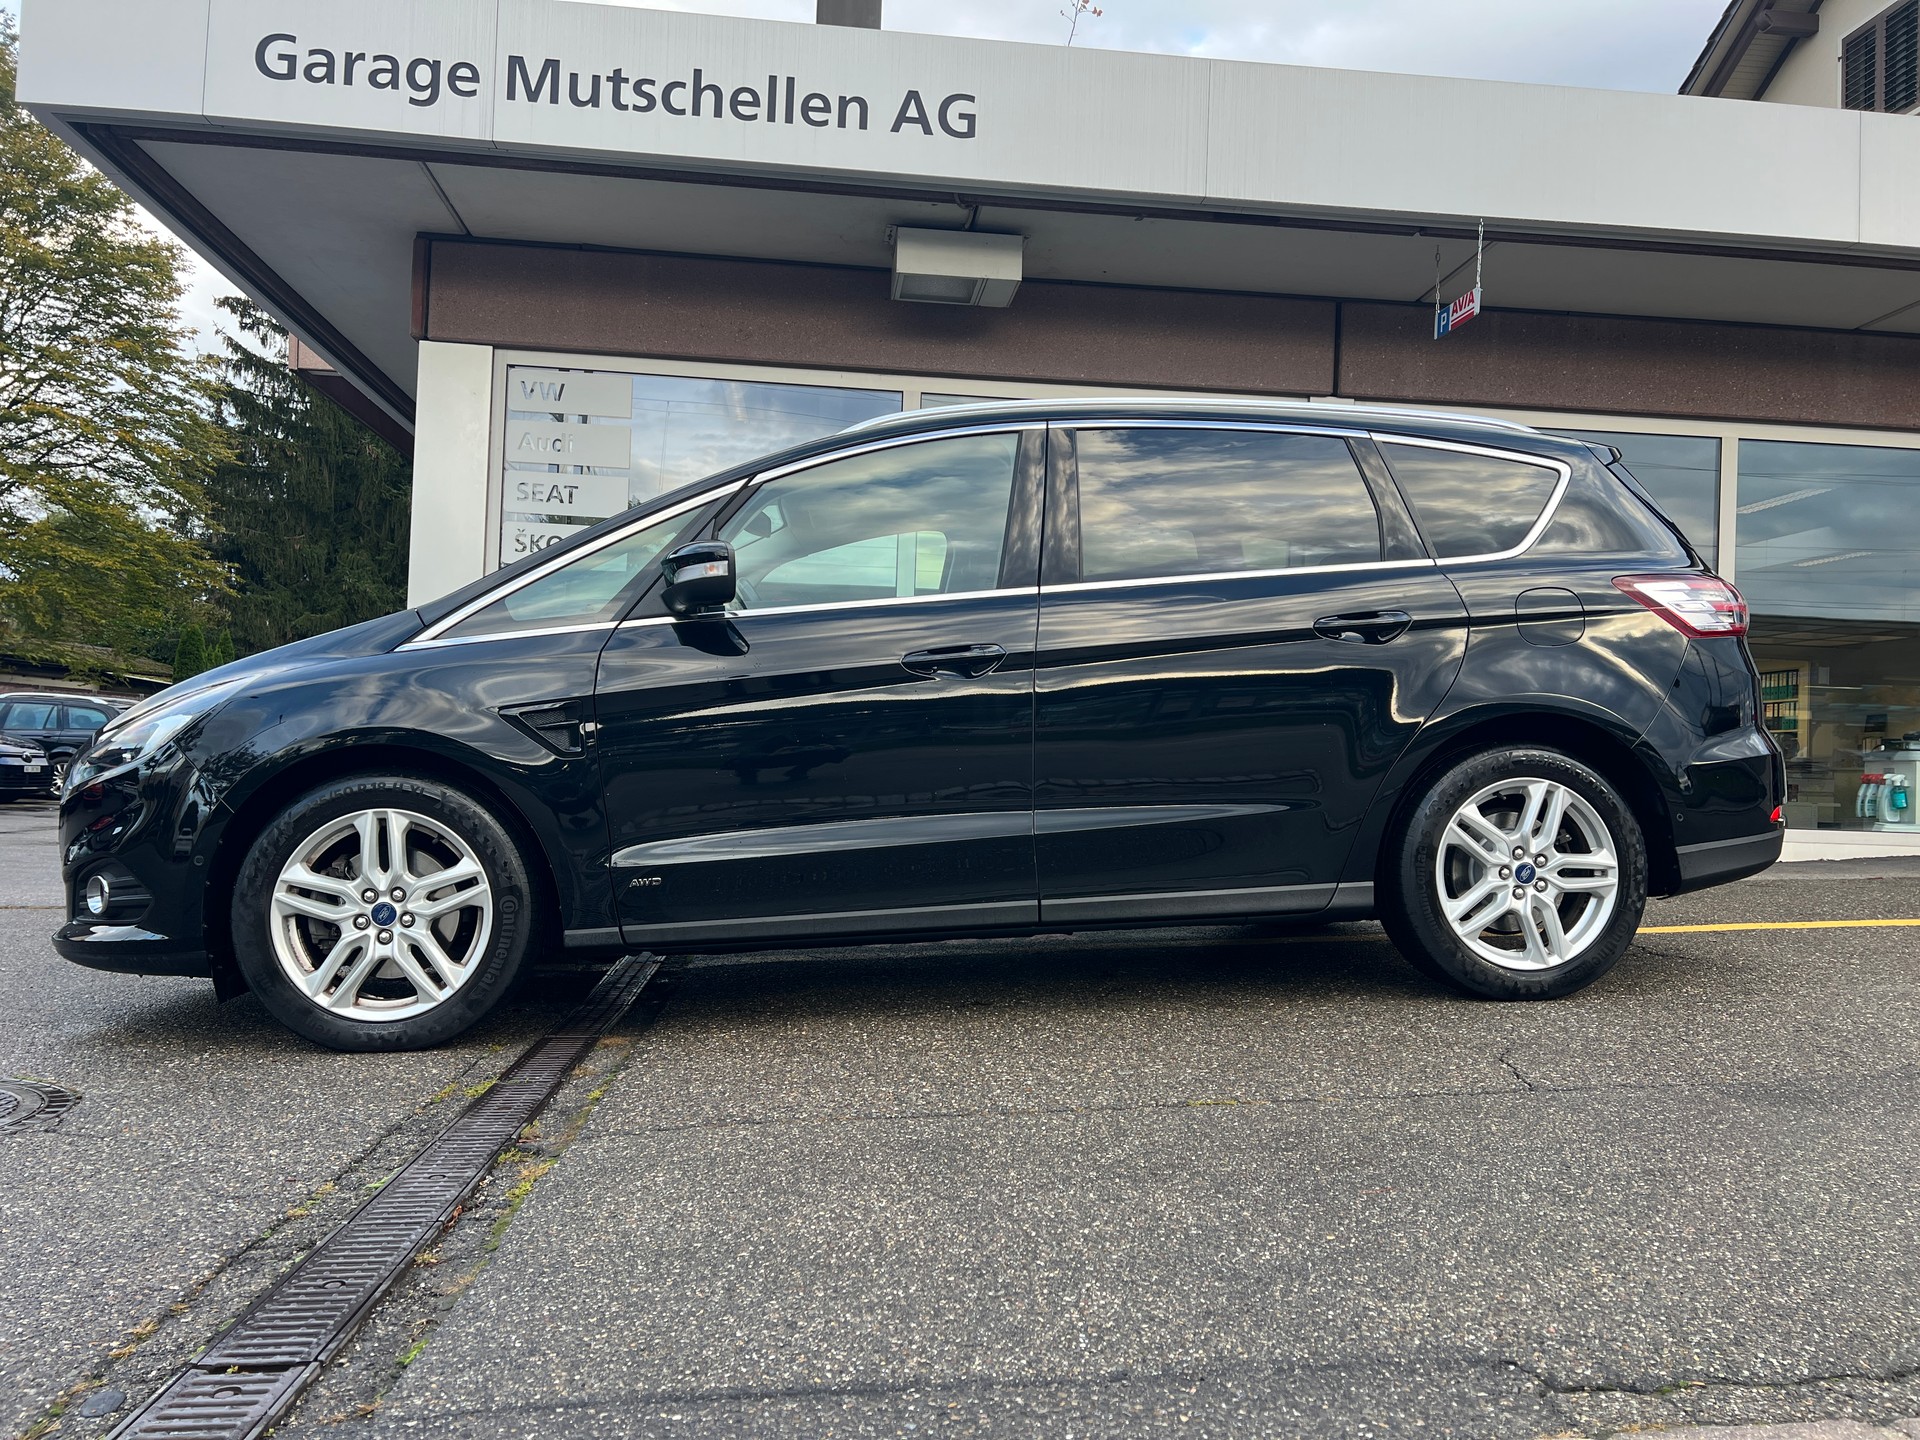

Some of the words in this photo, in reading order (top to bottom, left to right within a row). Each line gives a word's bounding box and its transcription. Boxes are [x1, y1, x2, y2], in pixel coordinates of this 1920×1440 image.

[255, 34, 480, 106] Garage
[506, 55, 868, 131] Mutschellen
[890, 90, 978, 139] AG
[1451, 291, 1475, 317] AVIA
[1440, 312, 1447, 333] P
[521, 381, 565, 401] VW
[518, 432, 573, 453] Audi
[517, 482, 579, 504] SEAT
[629, 877, 662, 888] AWD
